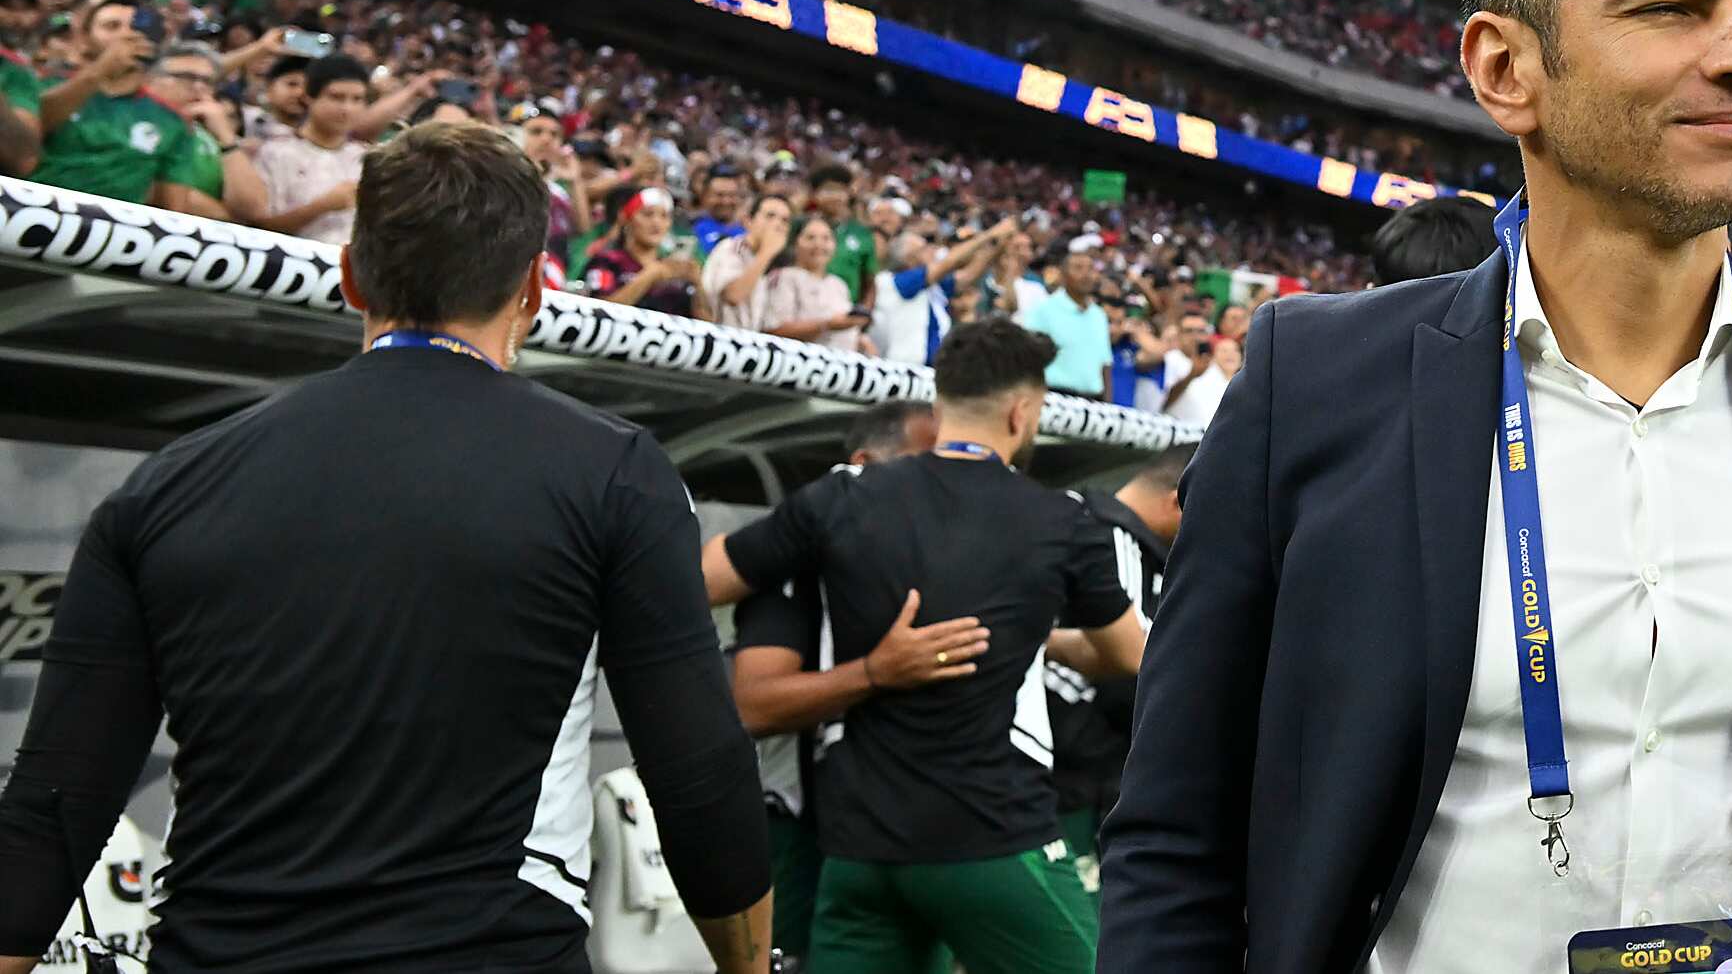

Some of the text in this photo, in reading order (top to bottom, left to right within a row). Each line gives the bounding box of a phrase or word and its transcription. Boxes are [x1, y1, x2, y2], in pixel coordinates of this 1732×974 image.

[1504, 402, 1526, 472] THIS IS OURS
[1518, 528, 1546, 683] Concacaf GOLD CUP
[1620, 944, 1712, 968] GOLD CUP
[1625, 939, 1665, 951] Concacaf
